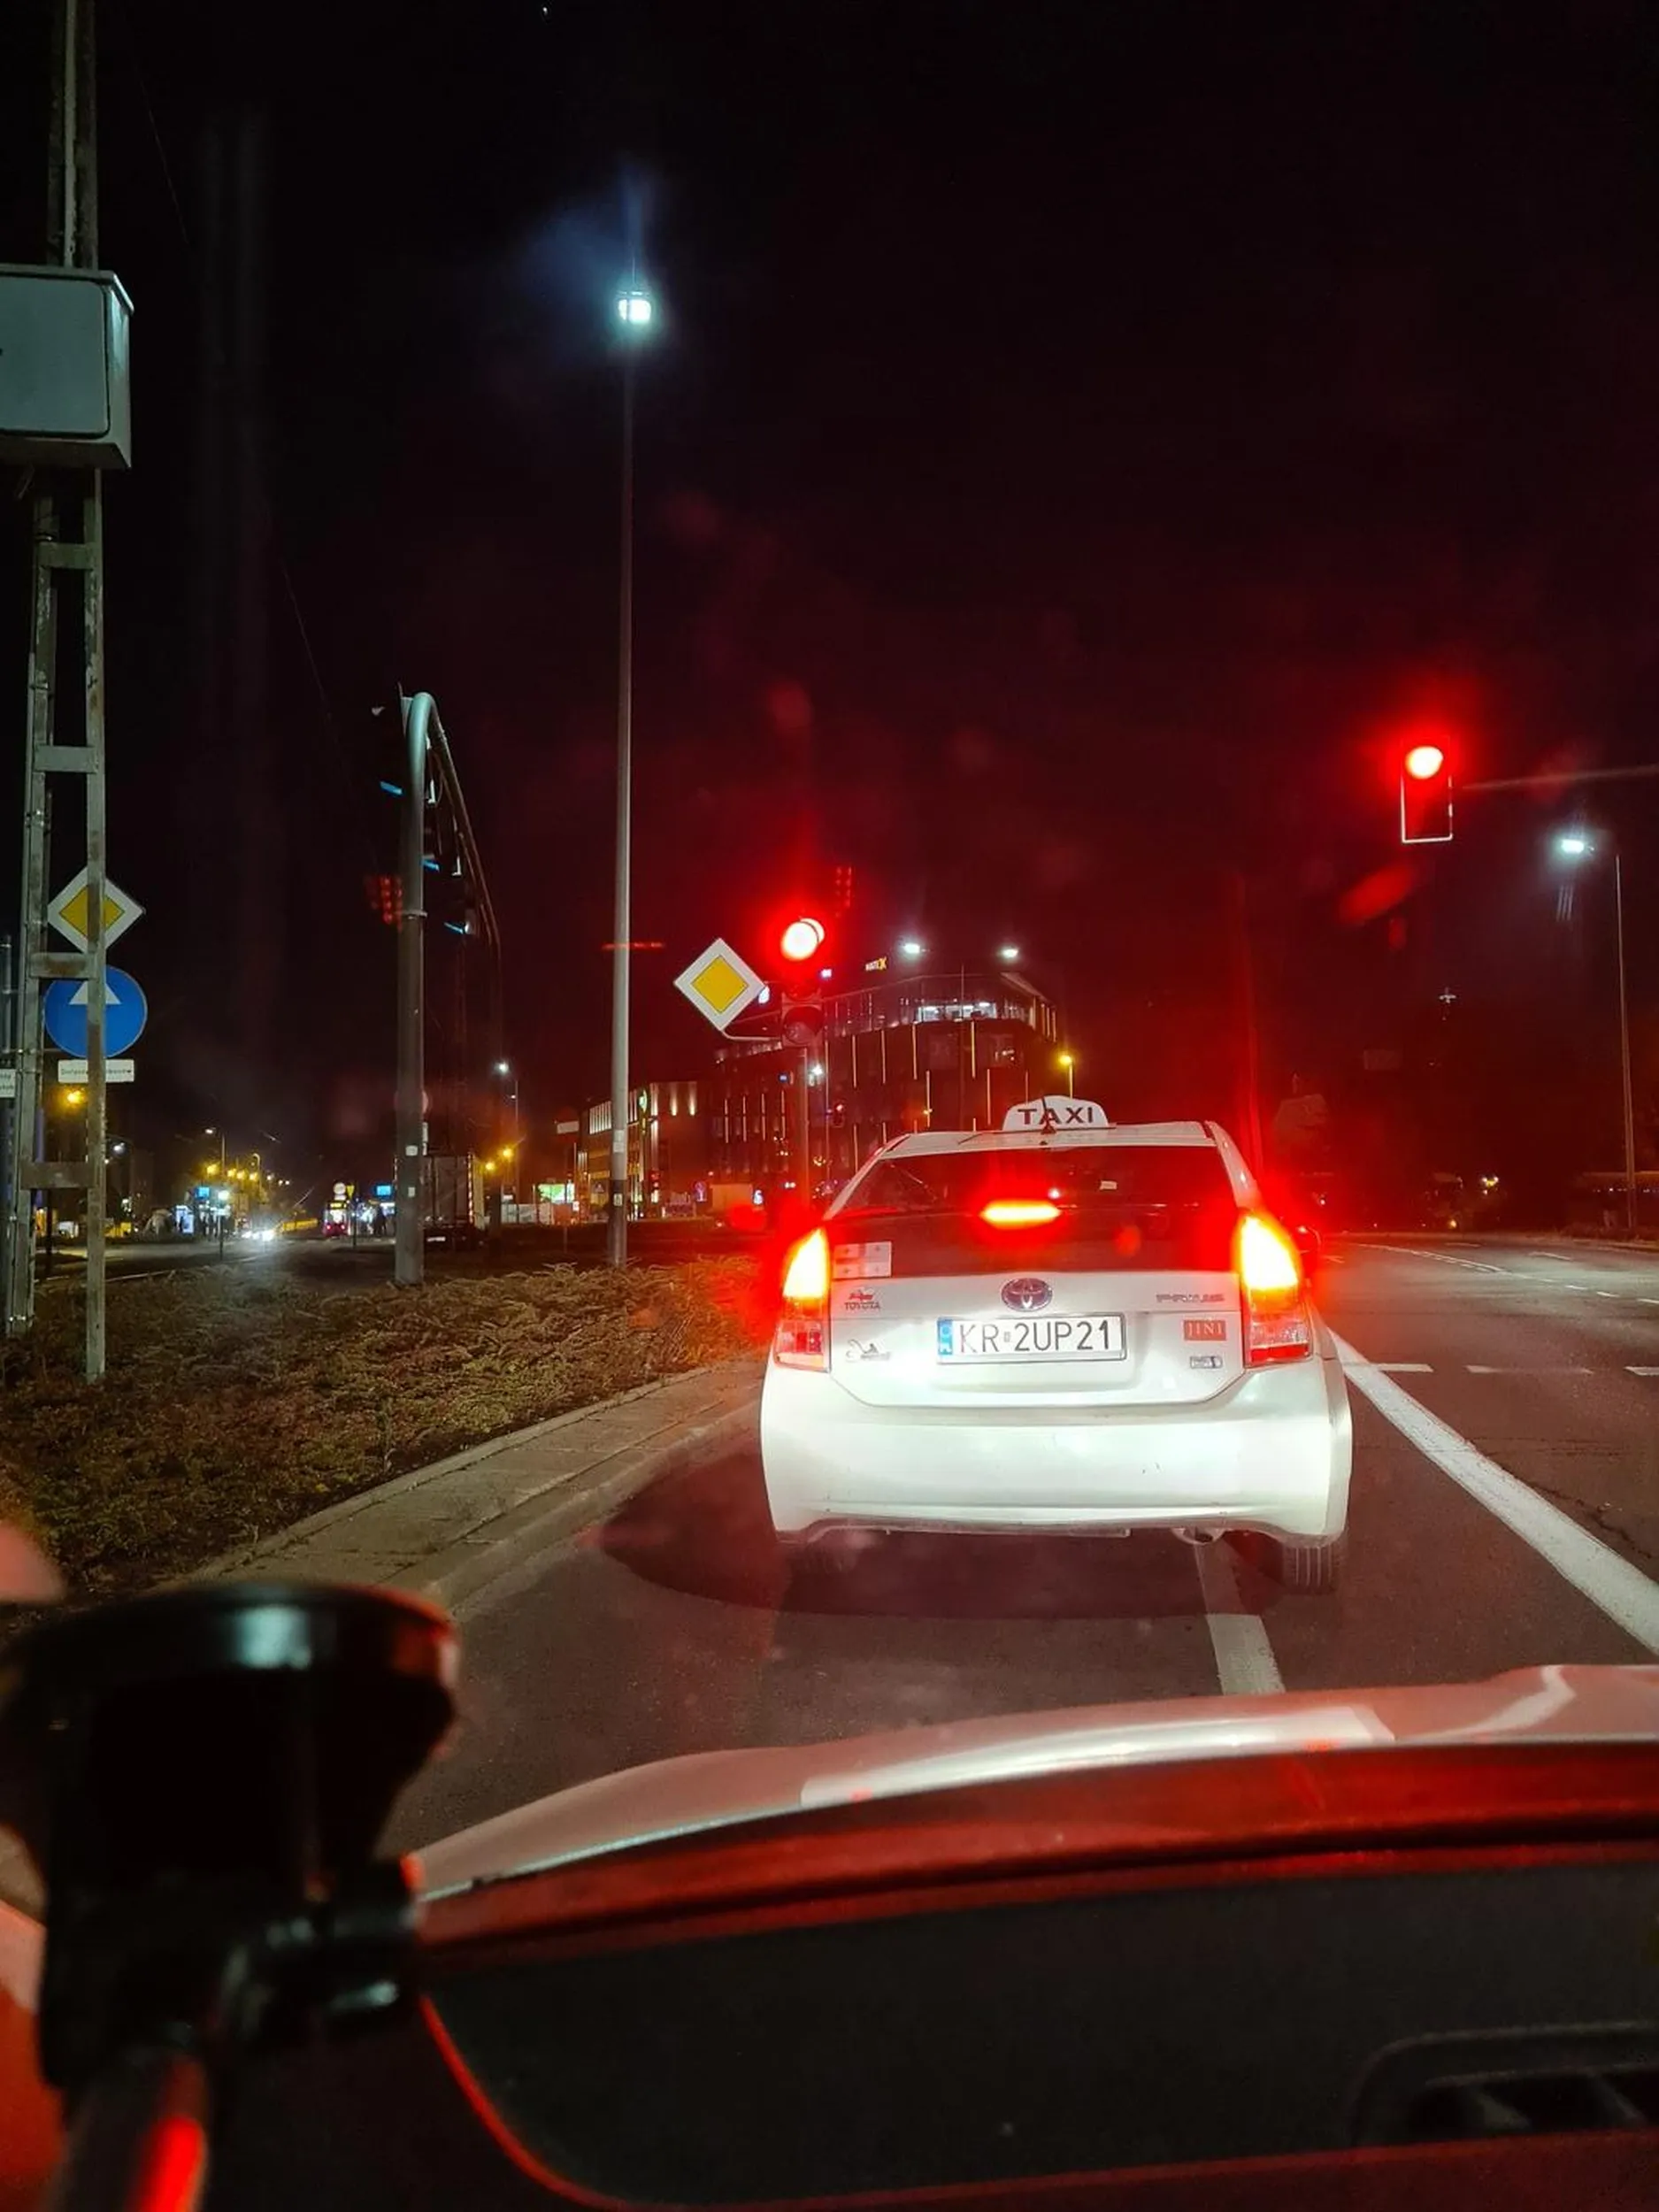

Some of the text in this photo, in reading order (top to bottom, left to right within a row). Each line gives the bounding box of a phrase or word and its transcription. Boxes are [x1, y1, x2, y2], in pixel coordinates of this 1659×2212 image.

[1018, 1106, 1094, 1125] TAXI
[844, 1302, 881, 1310] TOYOTA
[959, 1319, 1110, 1354] KR 2UP21
